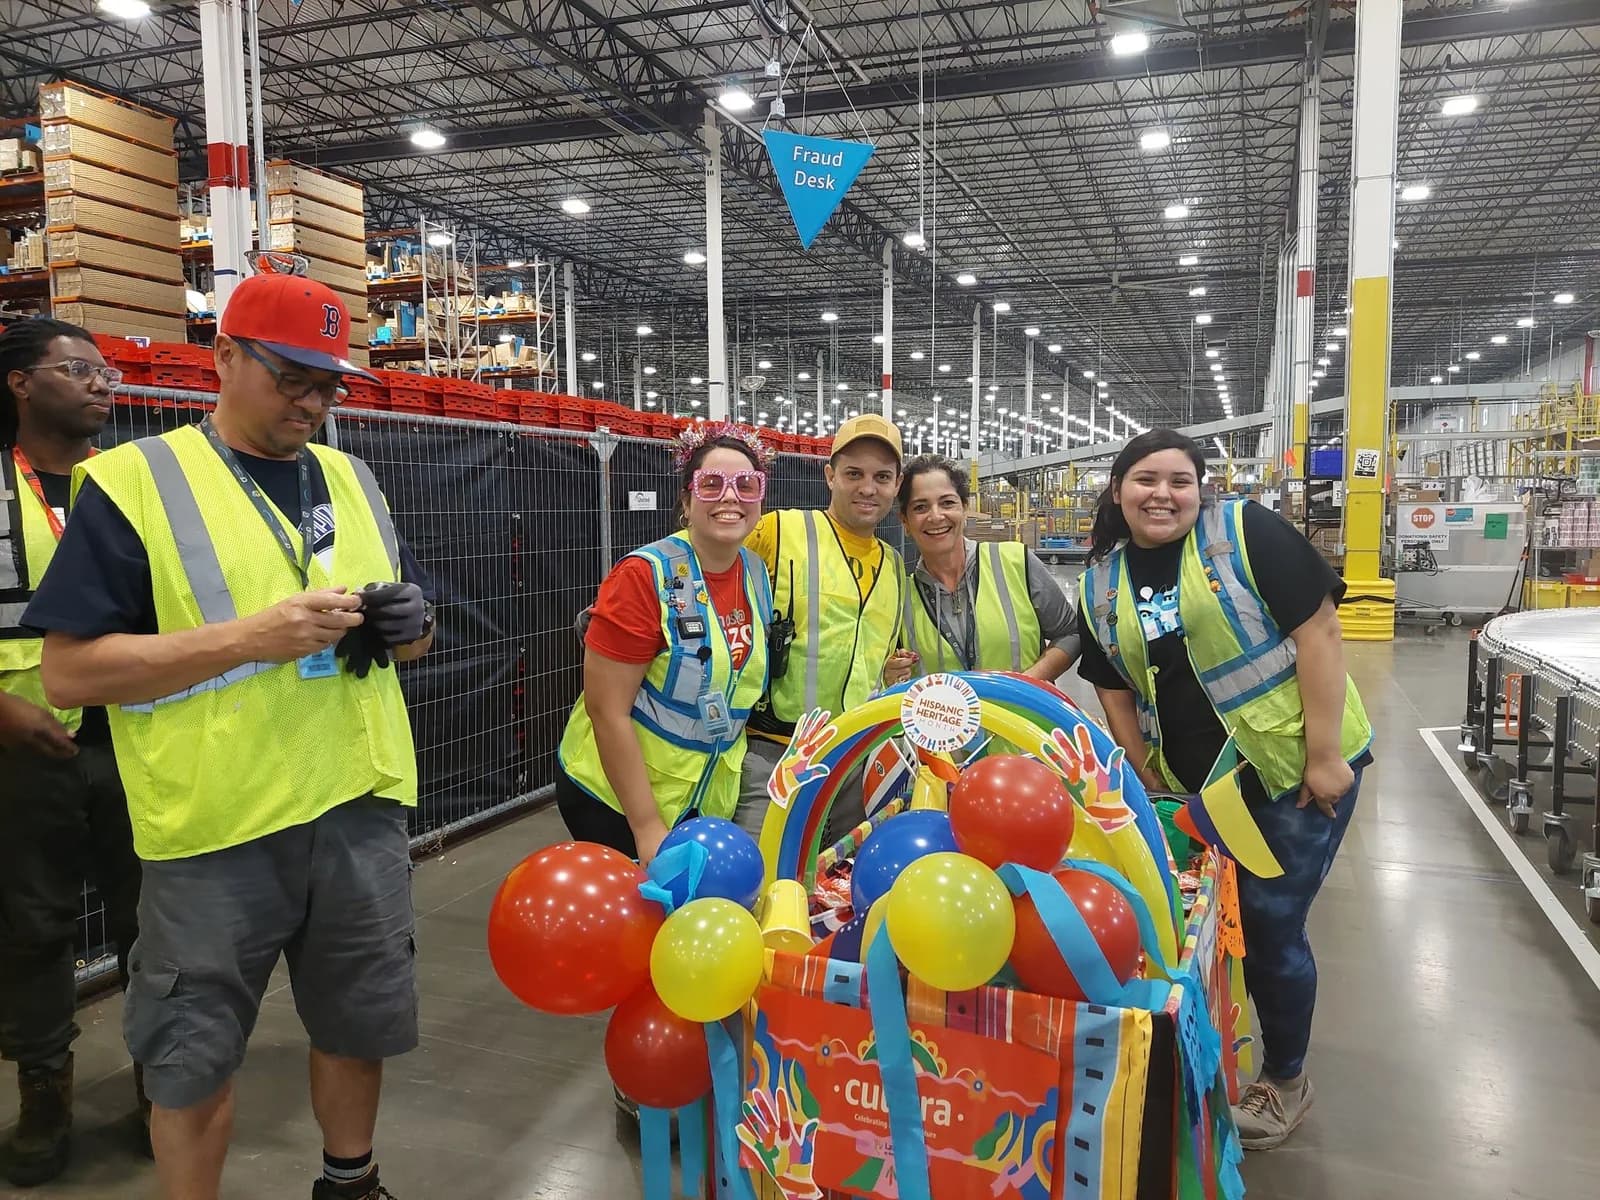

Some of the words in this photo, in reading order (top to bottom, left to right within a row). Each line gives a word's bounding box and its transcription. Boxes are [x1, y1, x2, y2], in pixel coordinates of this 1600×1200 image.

[793, 145, 843, 167] Fraud
[794, 170, 836, 190] Desk
[320, 303, 342, 339] B
[1413, 514, 1434, 522] STOP
[916, 707, 962, 727] HERITAGE
[919, 698, 965, 717] HISPANIC
[919, 718, 955, 733] MONTH
